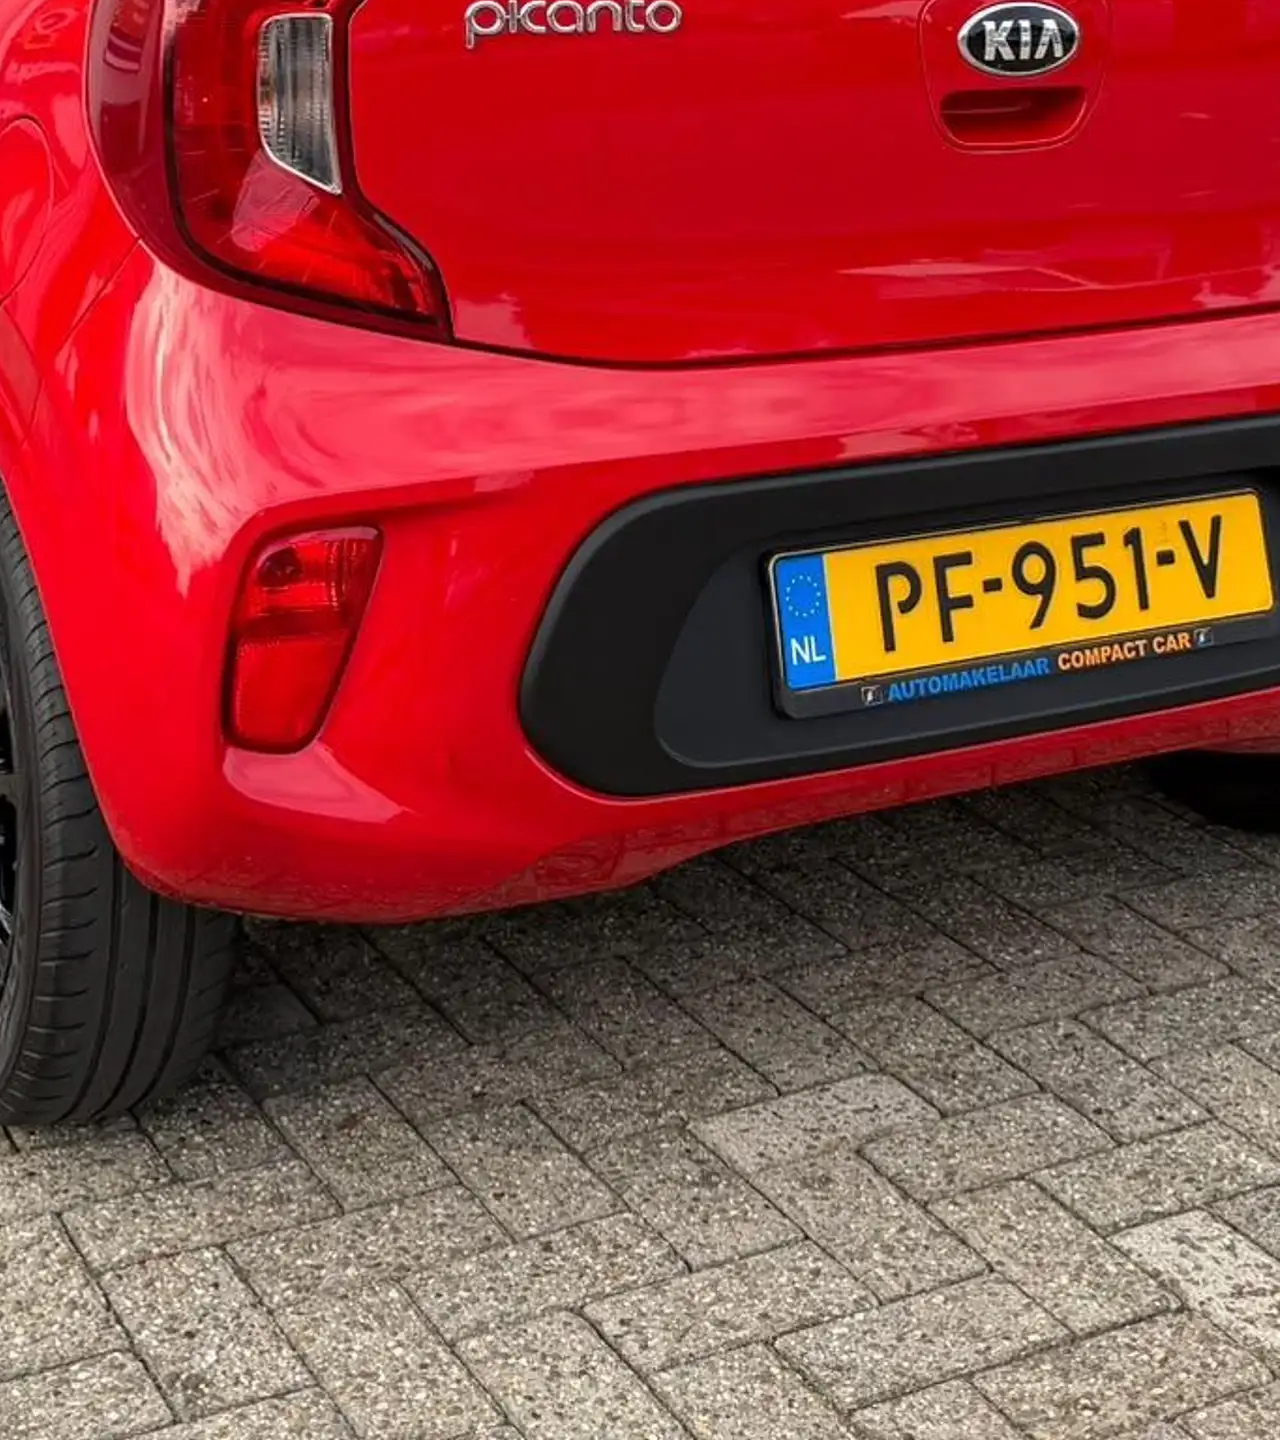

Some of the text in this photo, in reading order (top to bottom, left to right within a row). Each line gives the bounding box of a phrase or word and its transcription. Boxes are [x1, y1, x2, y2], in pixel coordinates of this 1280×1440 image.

[982, 19, 1064, 61] KIA
[875, 514, 1223, 653] PF-951-V
[790, 637, 826, 665] NL
[887, 630, 1192, 702] AUTOMAKELAAR COMPACT CAR
